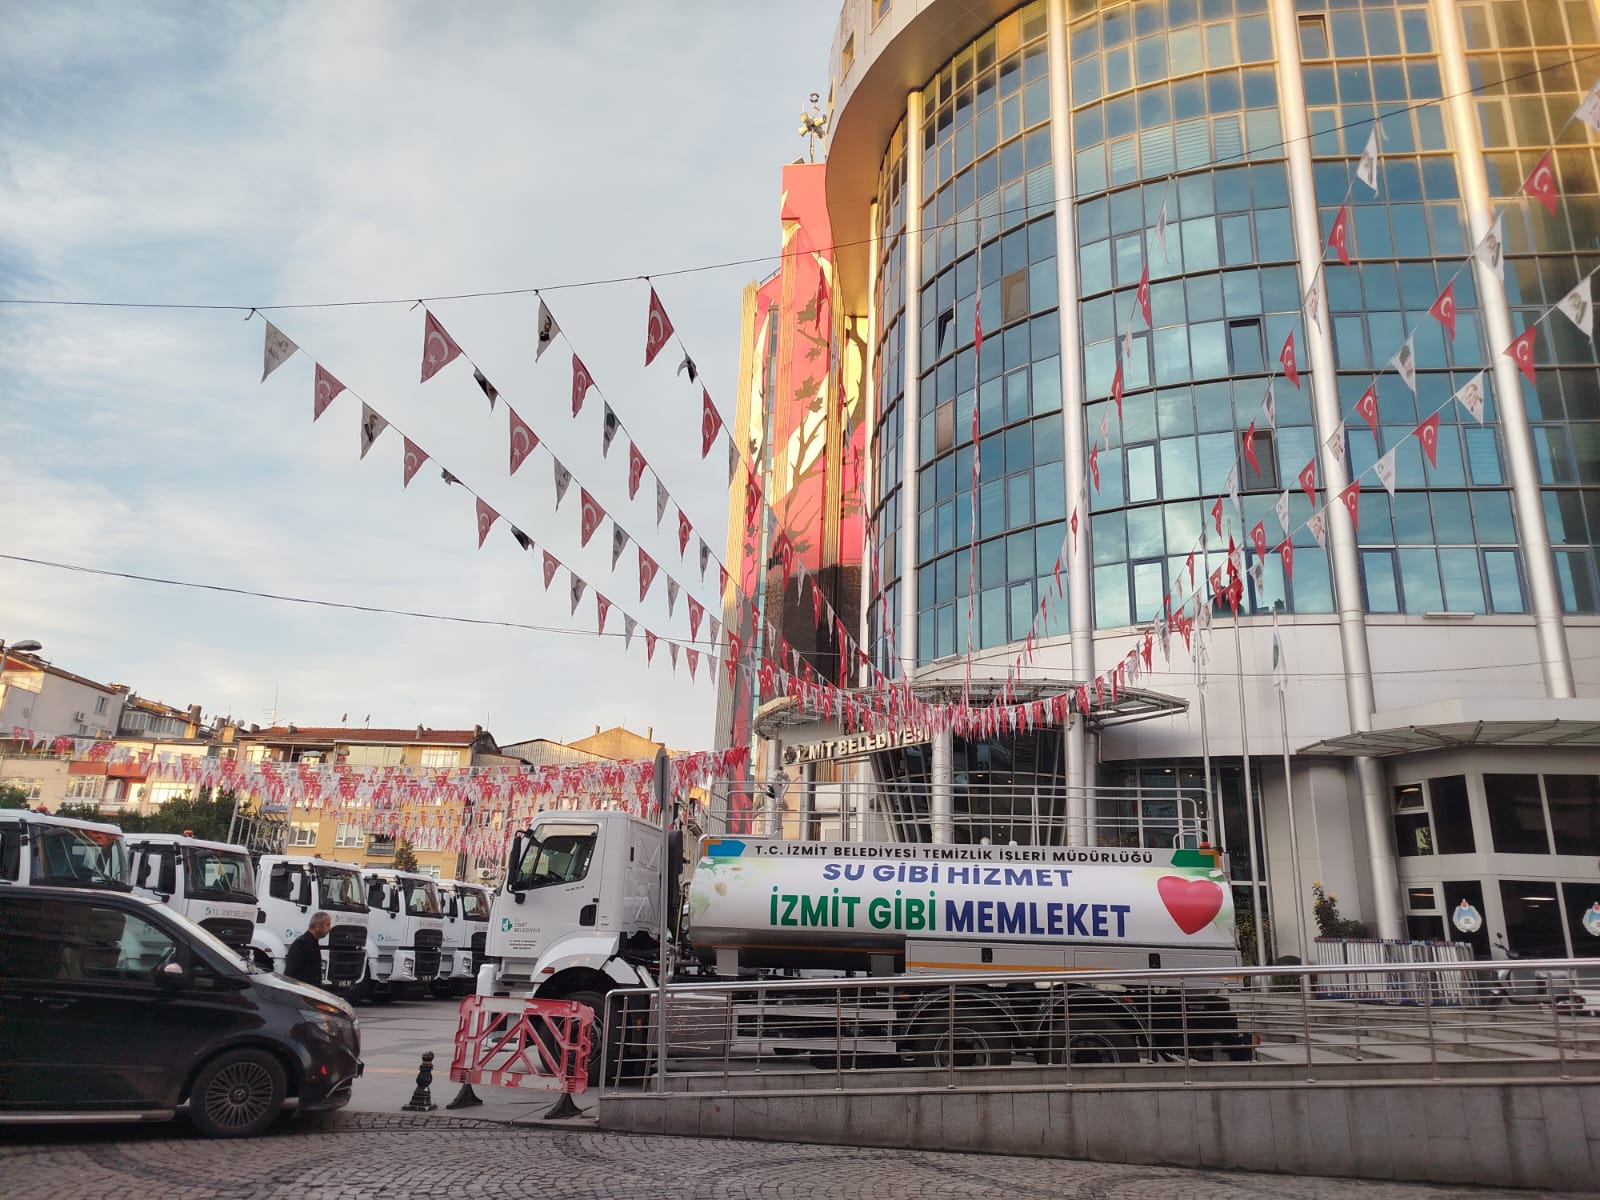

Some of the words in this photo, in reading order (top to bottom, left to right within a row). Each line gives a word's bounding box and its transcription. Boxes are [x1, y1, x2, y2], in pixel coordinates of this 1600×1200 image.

[755, 845, 783, 855] T.C.
[787, 843, 828, 856] İZMİT
[833, 844, 917, 858] BELEDİYESİ
[923, 846, 992, 860] TEMİZLİK
[999, 847, 1046, 862] İŞLERİ
[1053, 848, 1153, 864] MÜDÜRLÜĞÜ
[823, 863, 865, 881] SU
[872, 862, 939, 883] GİBİ
[948, 864, 1073, 887] HİZMET
[770, 886, 861, 928] İZMİT
[868, 889, 936, 932] GİBİ
[945, 899, 1131, 938] MEMLEKET
